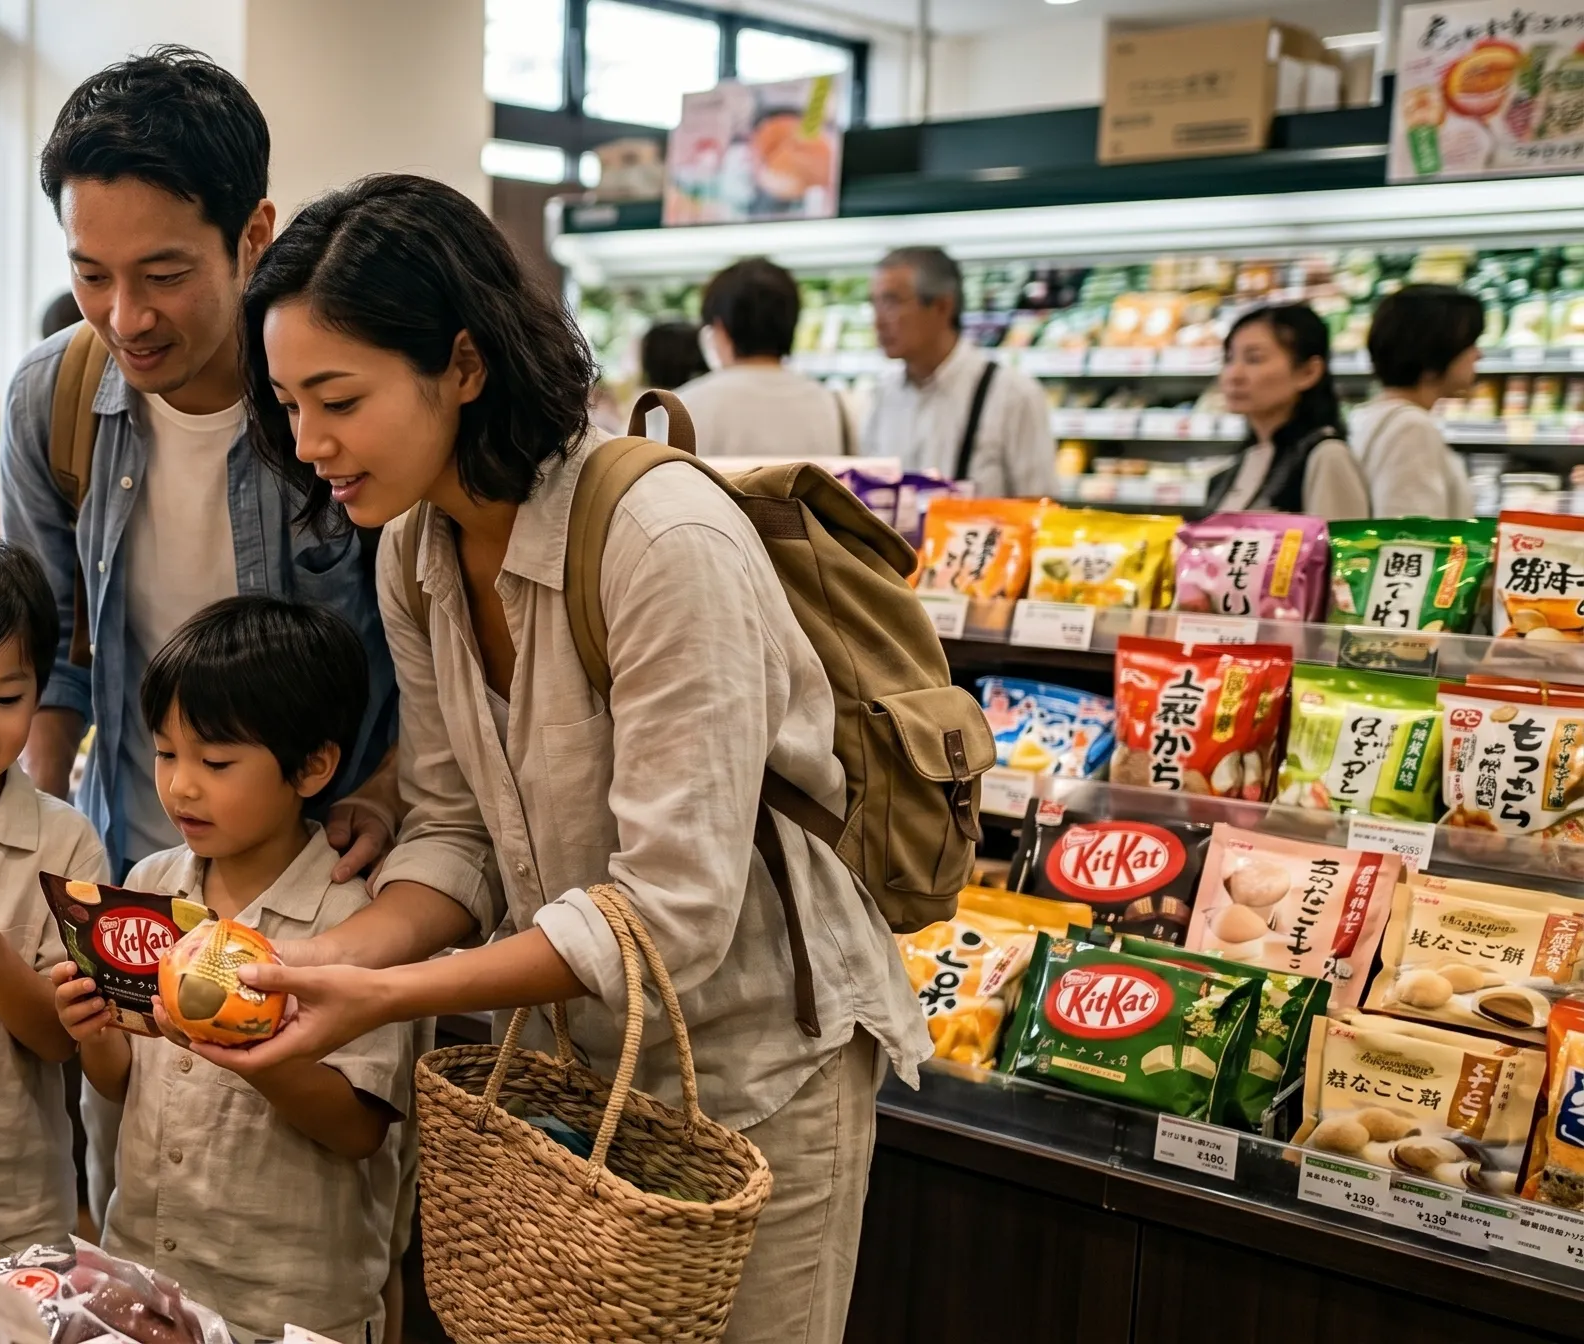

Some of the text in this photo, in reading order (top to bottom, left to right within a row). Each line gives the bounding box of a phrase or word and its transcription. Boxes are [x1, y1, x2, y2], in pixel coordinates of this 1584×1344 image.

[1071, 834, 1163, 886] KitKat
[110, 919, 170, 964] KitKat
[1066, 976, 1154, 1027] KitKat
